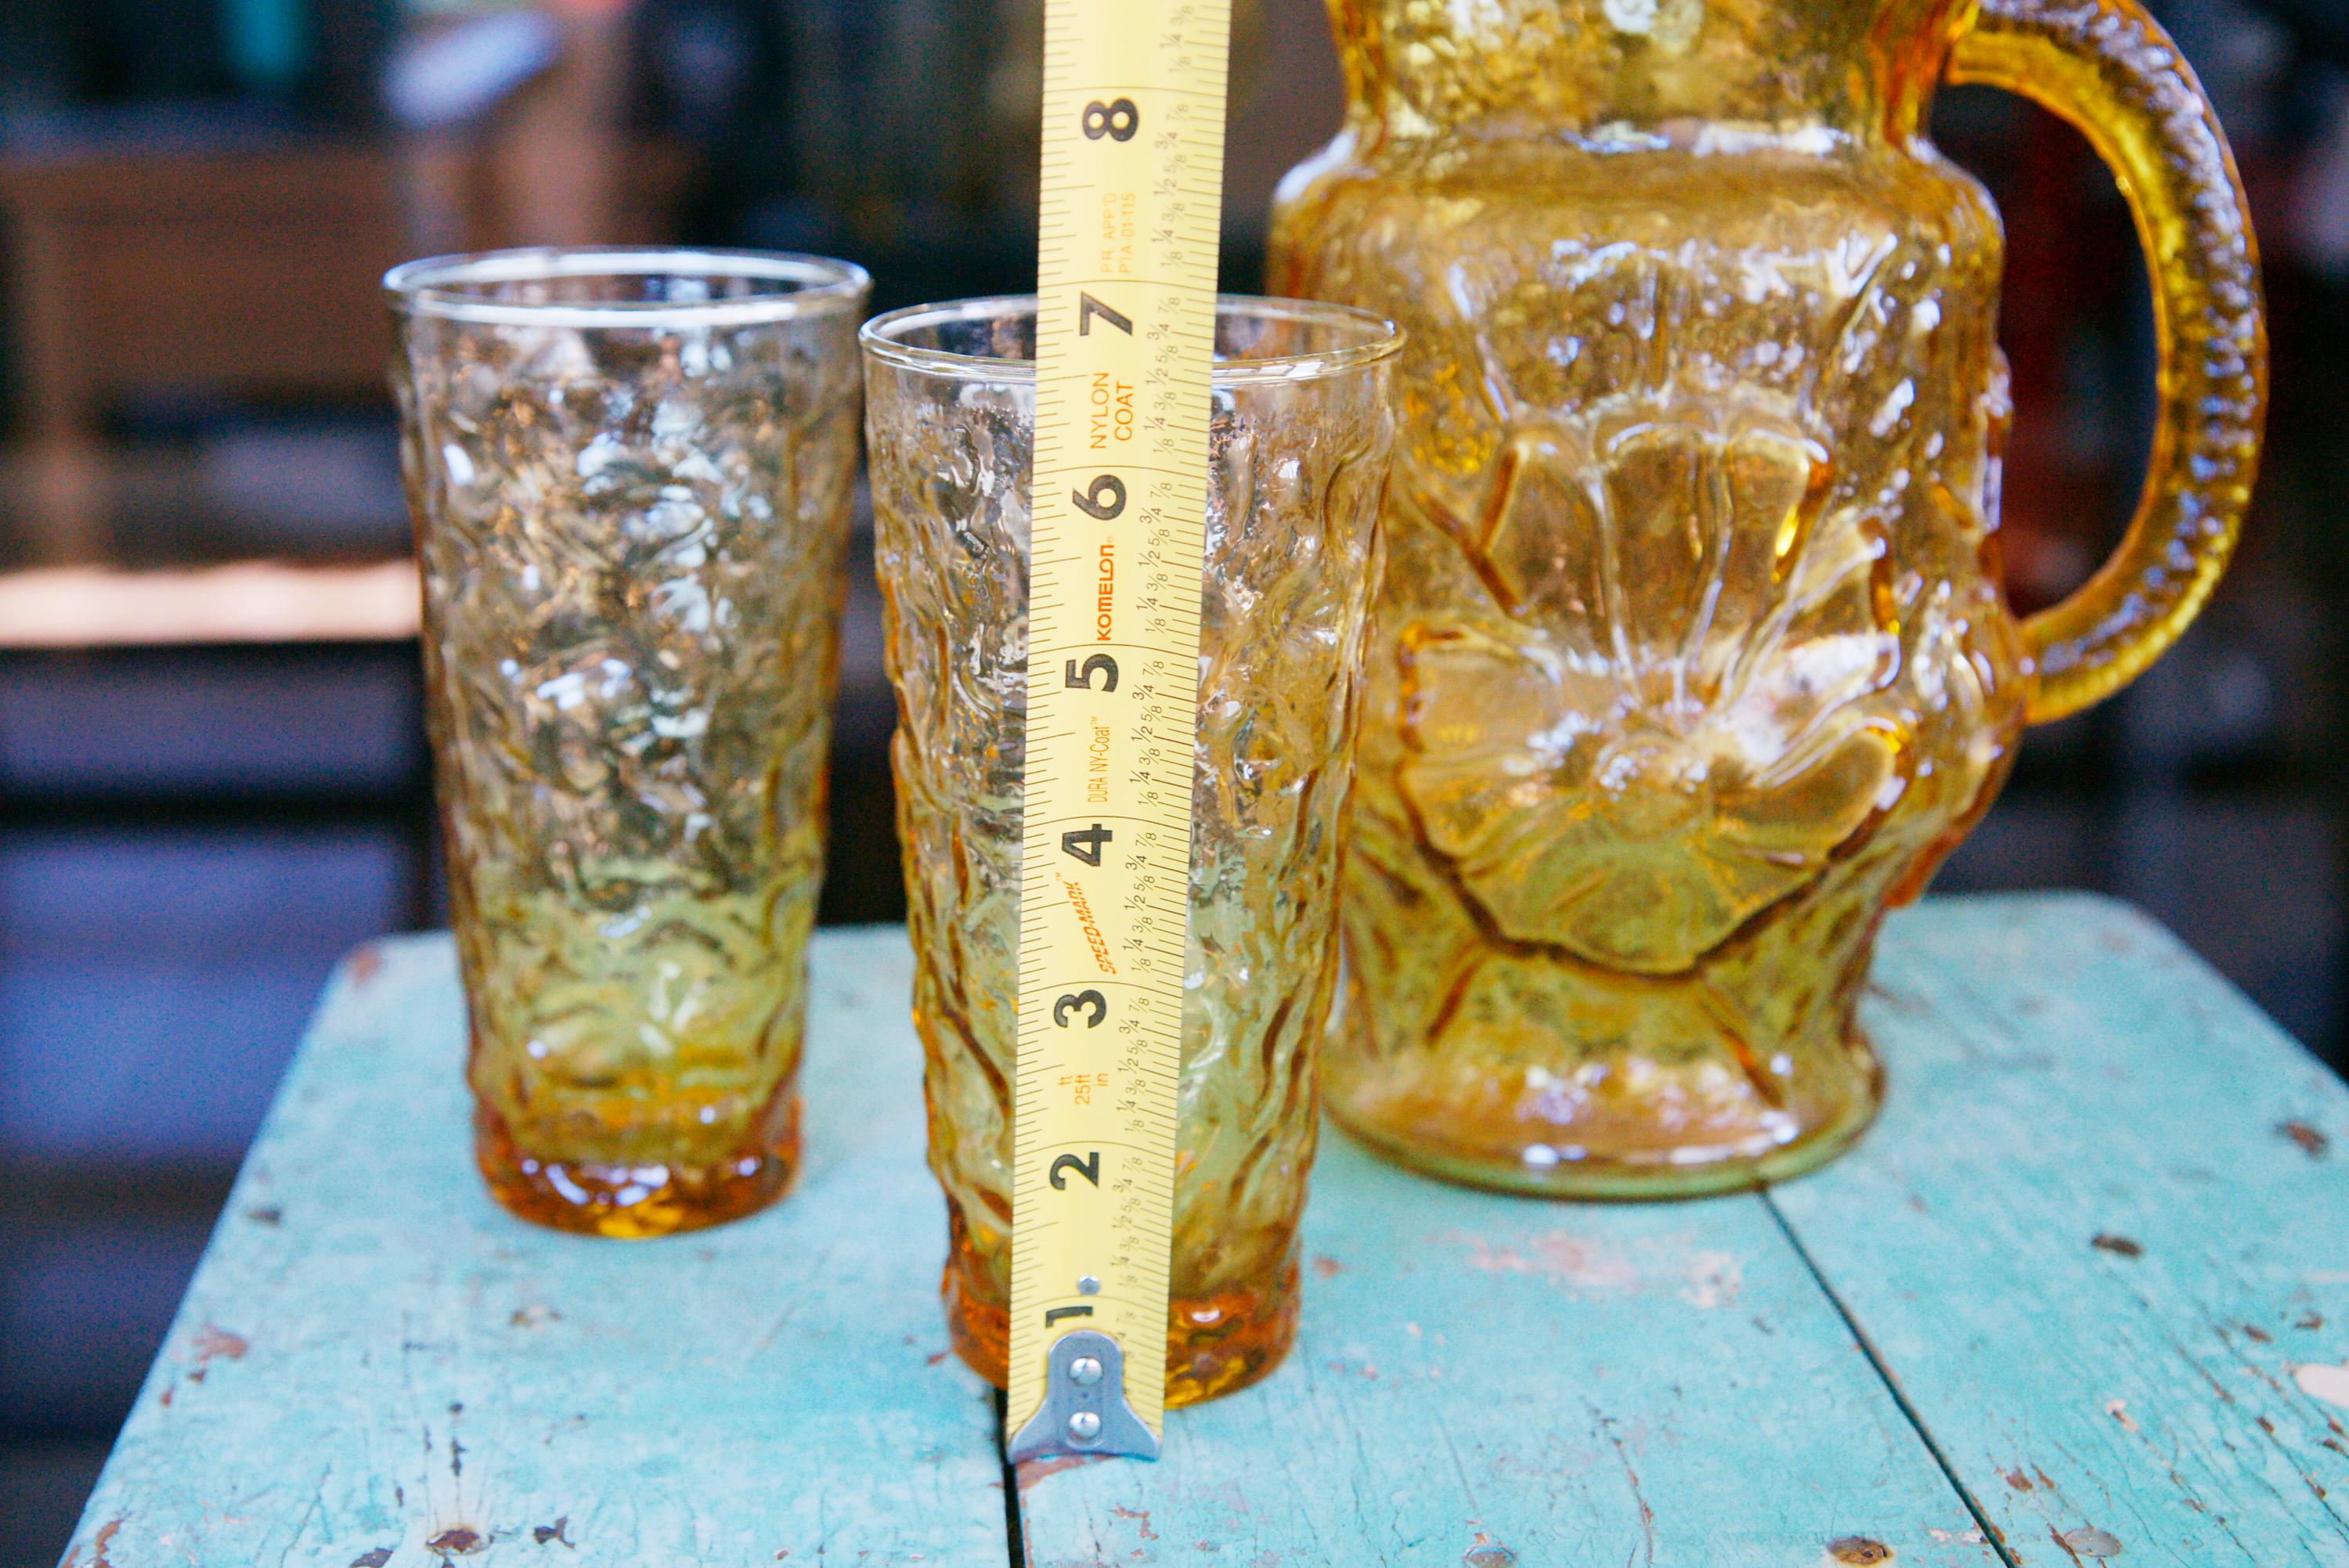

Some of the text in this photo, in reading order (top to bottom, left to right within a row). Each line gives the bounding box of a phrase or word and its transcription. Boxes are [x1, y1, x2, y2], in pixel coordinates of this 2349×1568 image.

[1082, 97, 1139, 142] 8
[1155, 132, 1178, 150] 3/4
[1153, 178, 1178, 196] 1/2
[1162, 203, 1185, 222] 3/8
[1151, 228, 1174, 243] 1/4
[1160, 251, 1182, 268] 1/8
[1080, 290, 1132, 336] 7
[1157, 297, 1180, 314] 7/8
[1147, 323, 1170, 340] 3/4
[1155, 345, 1178, 363] 5/8
[1146, 368, 1168, 385] 1/2
[1154, 391, 1176, 410] 3/8
[1090, 373, 1109, 449] NYLON
[1114, 380, 1133, 441] COAT
[1143, 416, 1166, 431] 1/4
[1152, 438, 1174, 454] 1/8
[1072, 474, 1126, 521] 6
[1149, 482, 1172, 499] 7/8
[1139, 507, 1162, 524] 3/4
[1148, 528, 1170, 546] 5/8
[1138, 550, 1160, 568] 1/2
[1146, 574, 1168, 591] 3/8
[1136, 597, 1158, 611] 1/4
[1145, 618, 1166, 634] 1/8
[1065, 653, 1119, 693] 5
[1143, 661, 1164, 676] 7/8
[1132, 684, 1155, 701] 3/4
[1141, 705, 1163, 722] 5/8
[1131, 726, 1153, 743] 1/2
[1139, 748, 1160, 766] 3/8
[1129, 770, 1151, 785] 1/4
[1088, 777, 1108, 802] DURA
[1138, 791, 1159, 807] 1/8
[1062, 824, 1113, 867] 4
[1135, 832, 1156, 848] 7/8
[1125, 854, 1147, 871] 3/4
[1134, 875, 1155, 891] 5/8
[1124, 895, 1146, 911] 1/2
[1131, 917, 1153, 933] 3/8
[1122, 938, 1144, 952] 1/4
[1131, 958, 1151, 974] 1/8
[1054, 989, 1106, 1029] 3
[1128, 997, 1149, 1014] 7/8
[1119, 1019, 1140, 1034] 3/4
[1128, 1039, 1148, 1054] 5/8
[1117, 1058, 1139, 1074] 1/2
[1125, 1079, 1146, 1095] 3/8
[1116, 1099, 1137, 1113] 1/4
[1124, 1119, 1145, 1134] 1/8
[1049, 1152, 1099, 1191] 2
[1113, 1177, 1133, 1192] 3/4
[1045, 1306, 1093, 1328] 1
